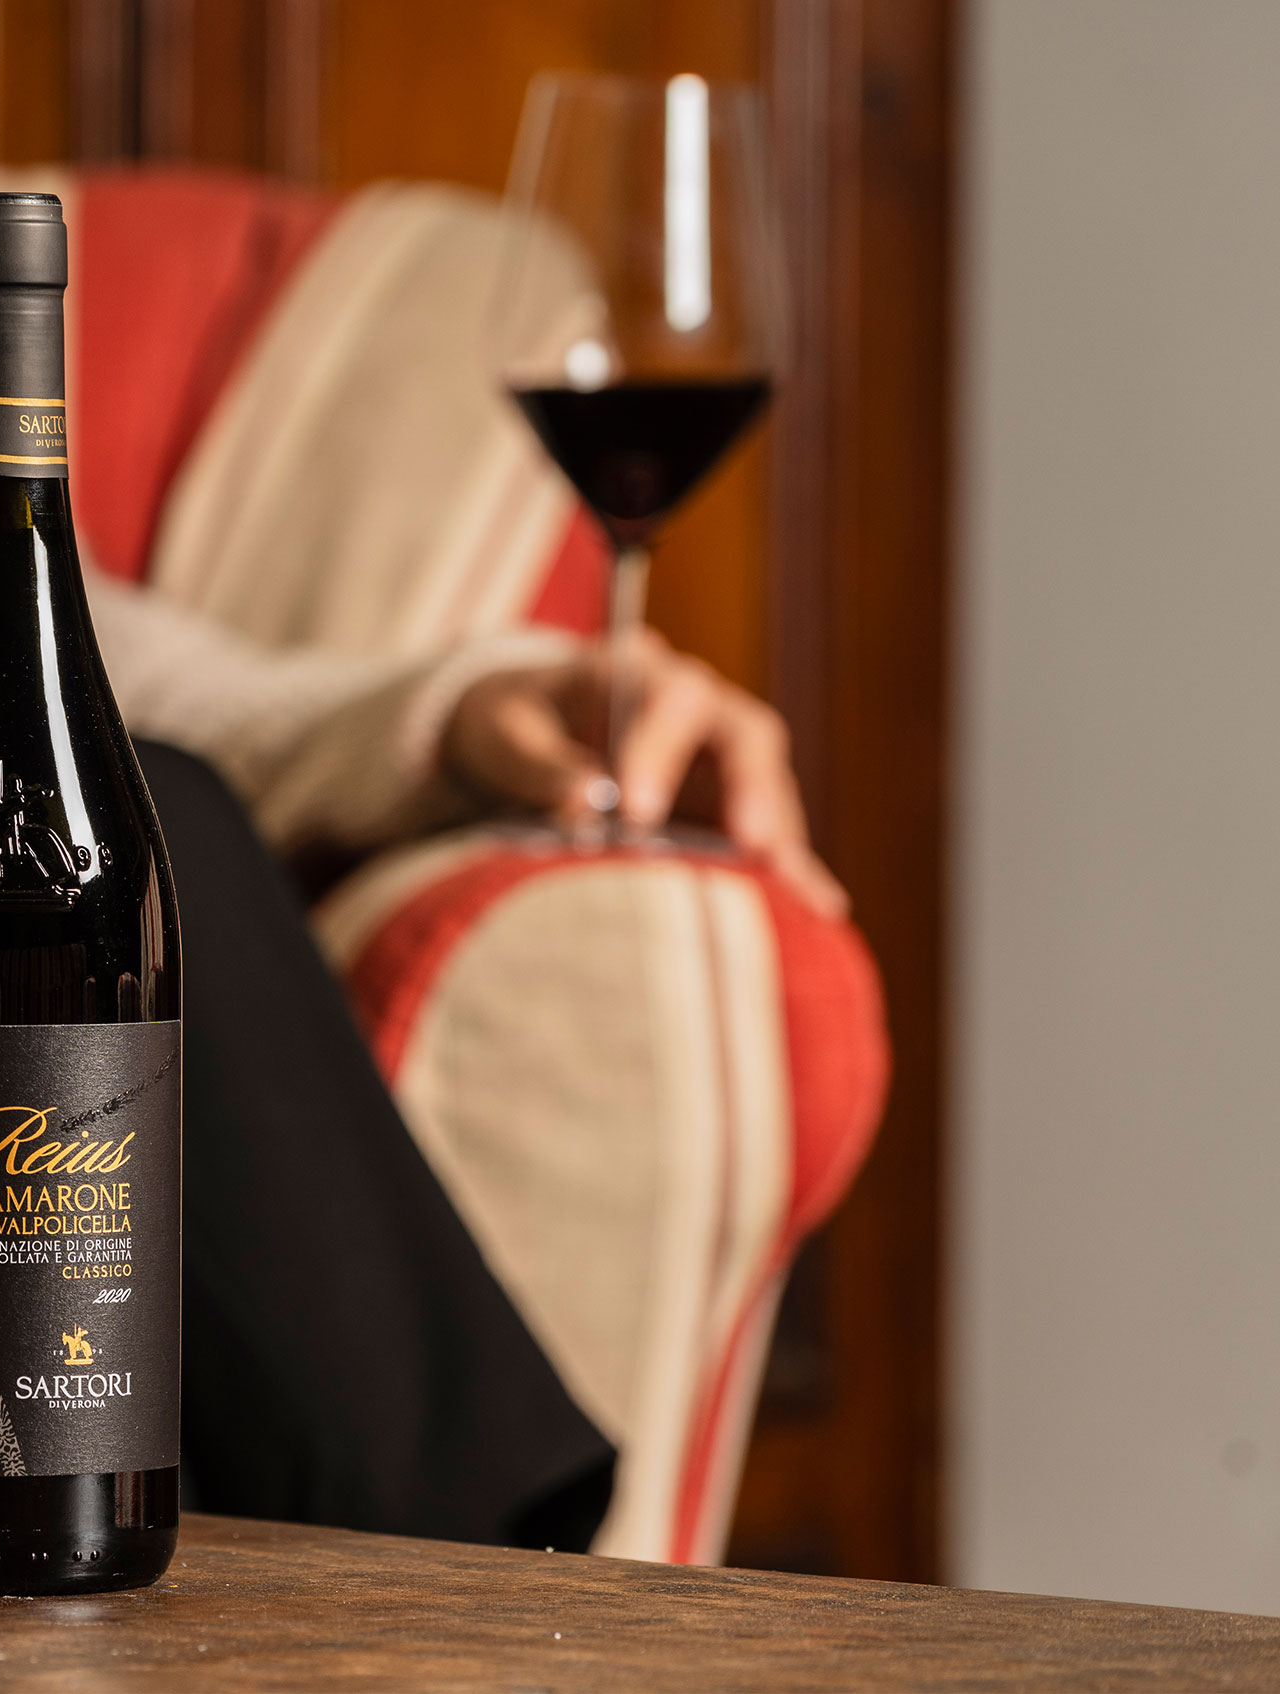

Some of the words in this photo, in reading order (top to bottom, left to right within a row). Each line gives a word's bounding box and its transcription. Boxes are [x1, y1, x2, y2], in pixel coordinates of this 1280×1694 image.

[18, 414, 66, 434] SARTO
[67, 1240, 79, 1251] DI
[84, 1237, 132, 1250] ORIGINE
[55, 1252, 62, 1263] E
[67, 1250, 132, 1263] GARANTITA
[62, 1264, 132, 1280] CLASSICO
[92, 1287, 131, 1304] 2020
[15, 1372, 132, 1399] SARTORI
[49, 1400, 60, 1409] DI
[61, 1399, 106, 1411] VERONA
